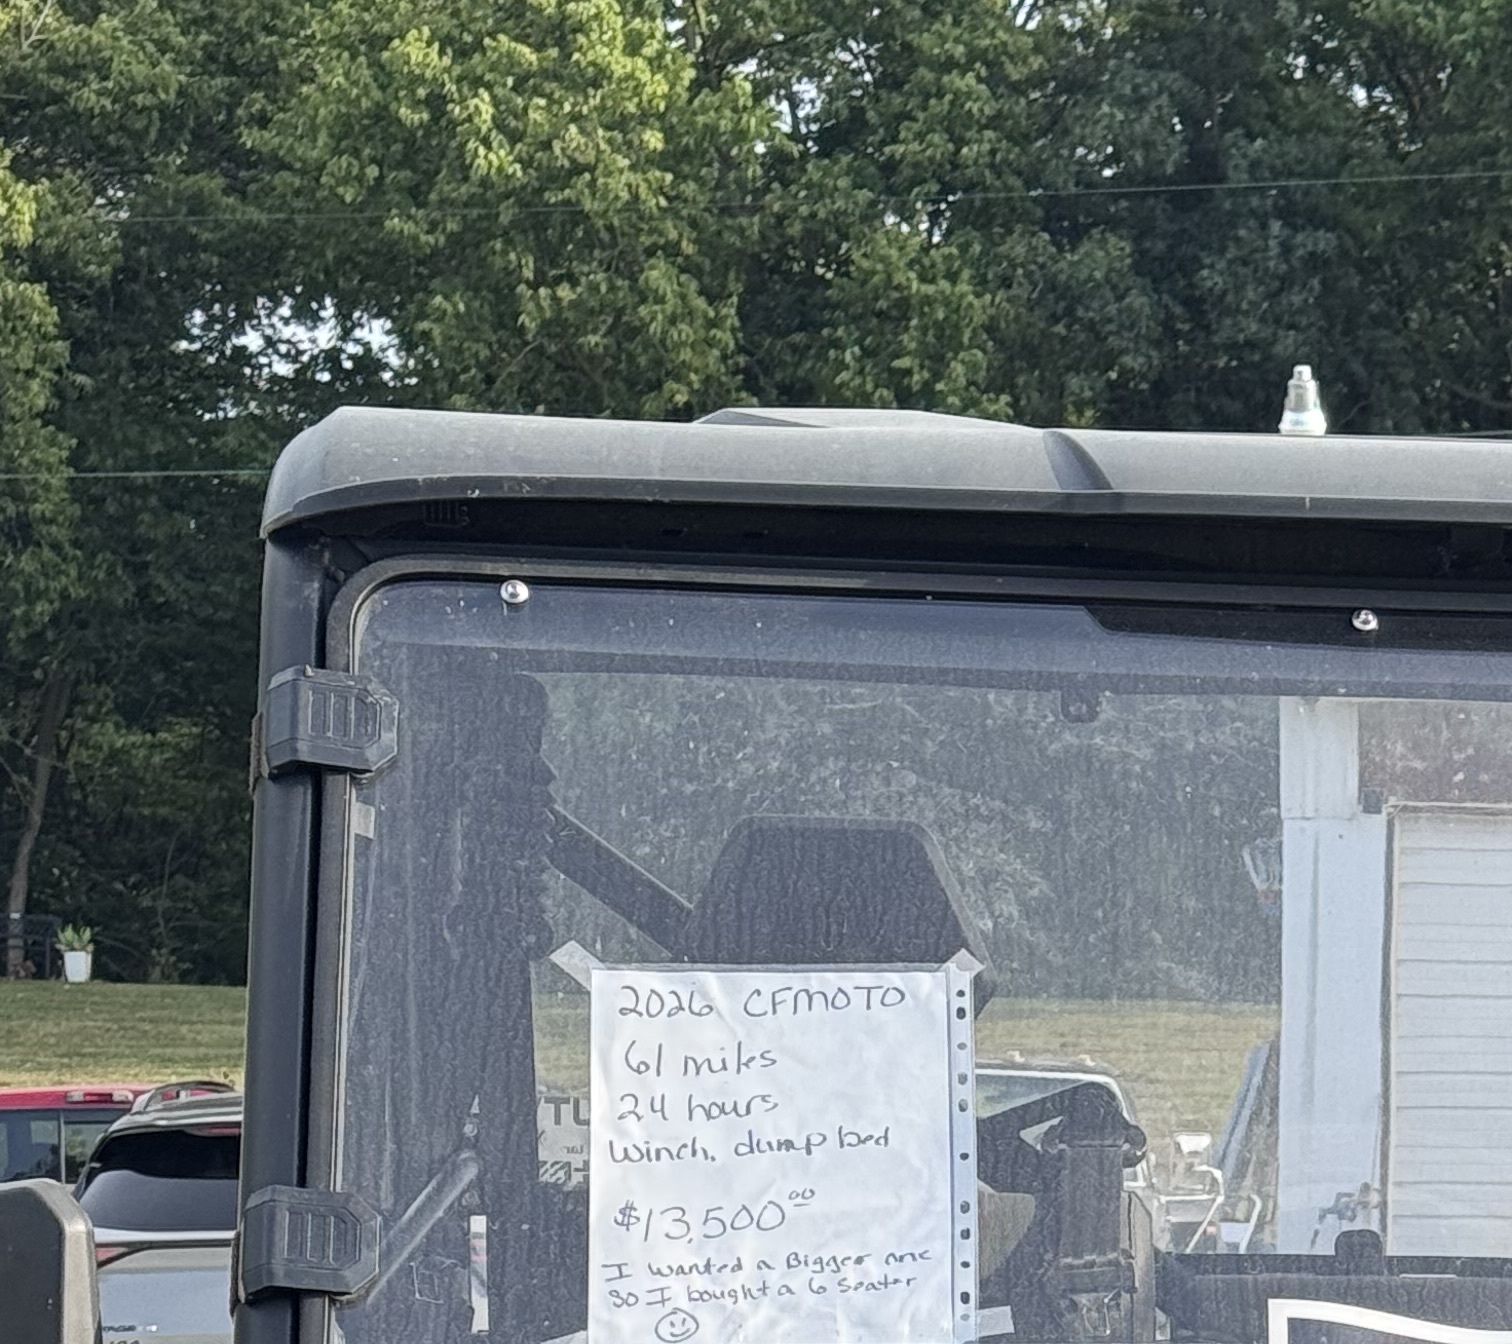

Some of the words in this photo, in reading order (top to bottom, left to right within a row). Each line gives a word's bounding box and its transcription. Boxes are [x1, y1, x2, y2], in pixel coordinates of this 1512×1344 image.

[618, 985, 714, 1018] 2026
[624, 1040, 662, 1077] 61
[683, 1041, 777, 1077] miles
[617, 1093, 669, 1122] 24
[688, 1093, 779, 1122] hours
[733, 1129, 827, 1156] dump
[838, 1125, 890, 1149] bed
[601, 1262, 633, 1283] I
[648, 1256, 743, 1277] wanted
[757, 1259, 776, 1271] a
[884, 1249, 932, 1266] one
[645, 1286, 672, 1308] I
[687, 1280, 770, 1305] bought
[777, 1284, 796, 1296] a
[808, 1276, 827, 1295] 6
